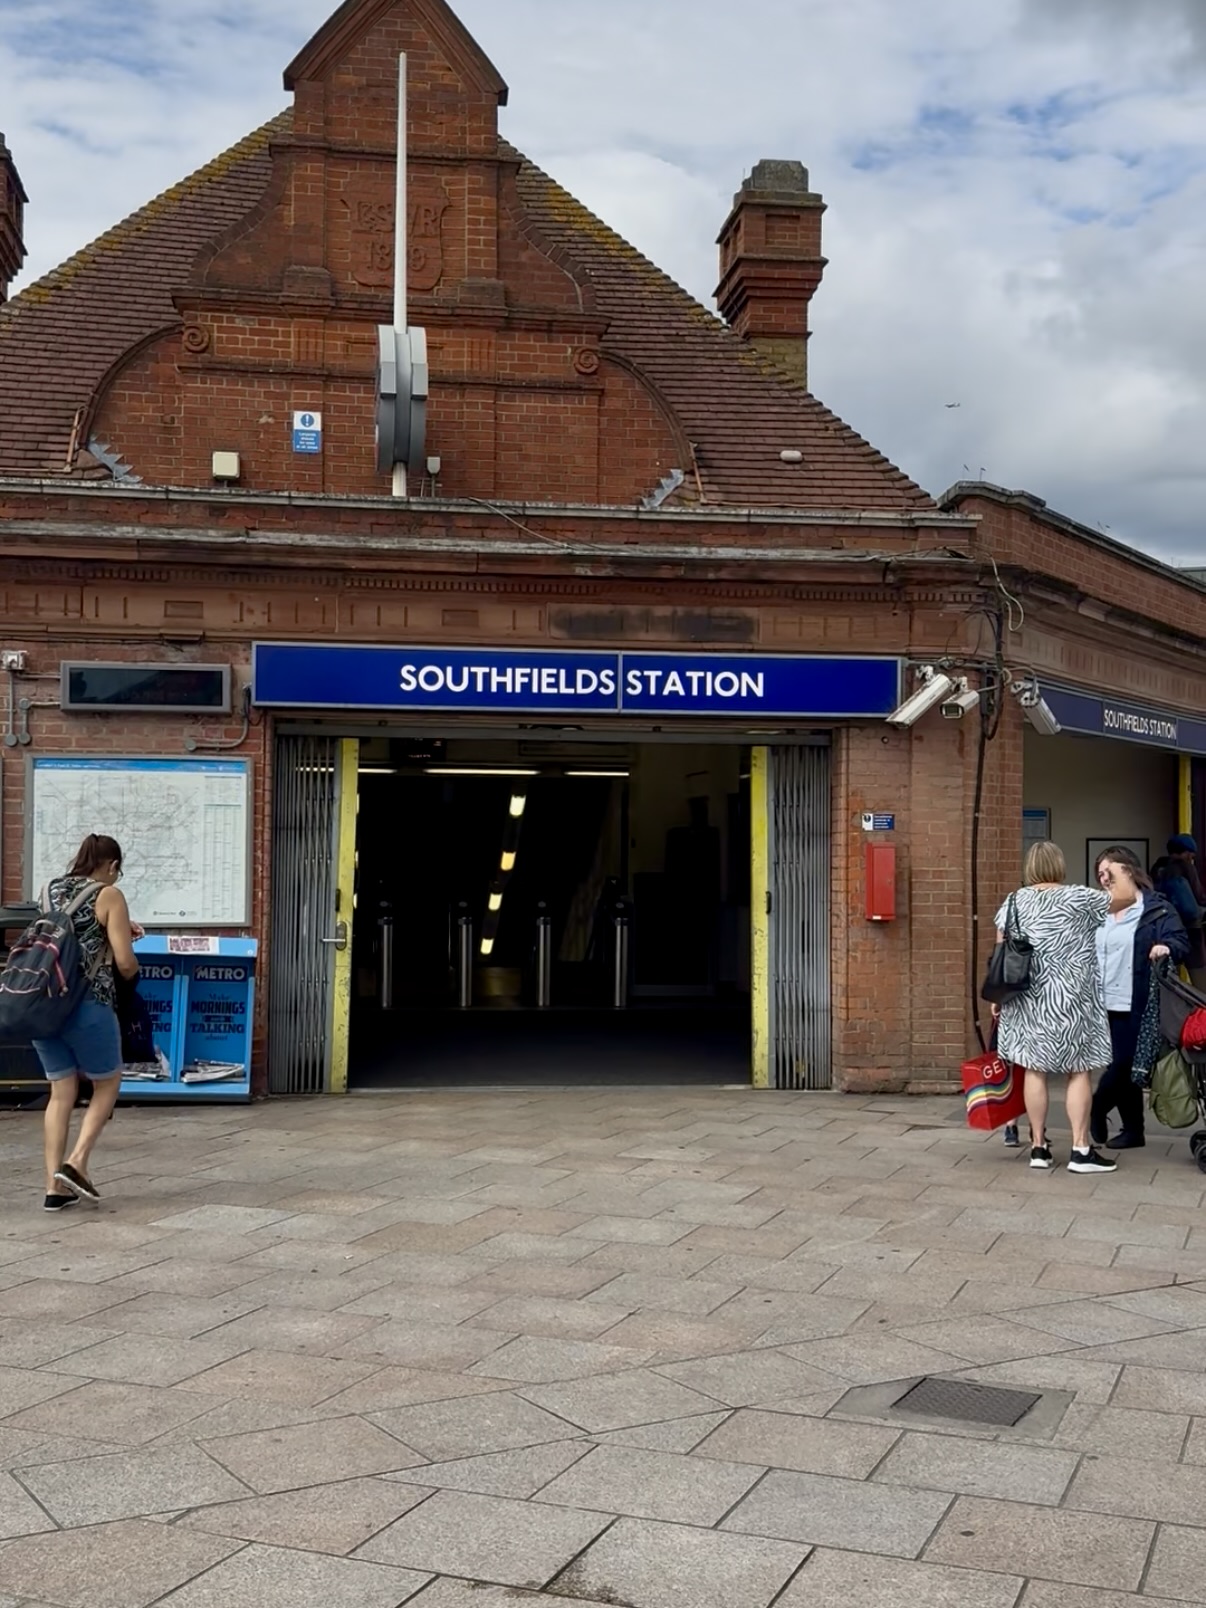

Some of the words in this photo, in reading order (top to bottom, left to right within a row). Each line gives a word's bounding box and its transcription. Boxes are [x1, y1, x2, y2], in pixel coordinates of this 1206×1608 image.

[400, 664, 615, 695] SOUTHFIELDS
[626, 669, 765, 698] STATION
[1104, 709, 1149, 735] SOUTHFIELDS
[1149, 719, 1177, 740] STATION
[139, 966, 173, 979] ETRO
[196, 966, 245, 980] METRO
[190, 1000, 246, 1015] MORNINGS
[189, 1022, 246, 1034] TALKING
